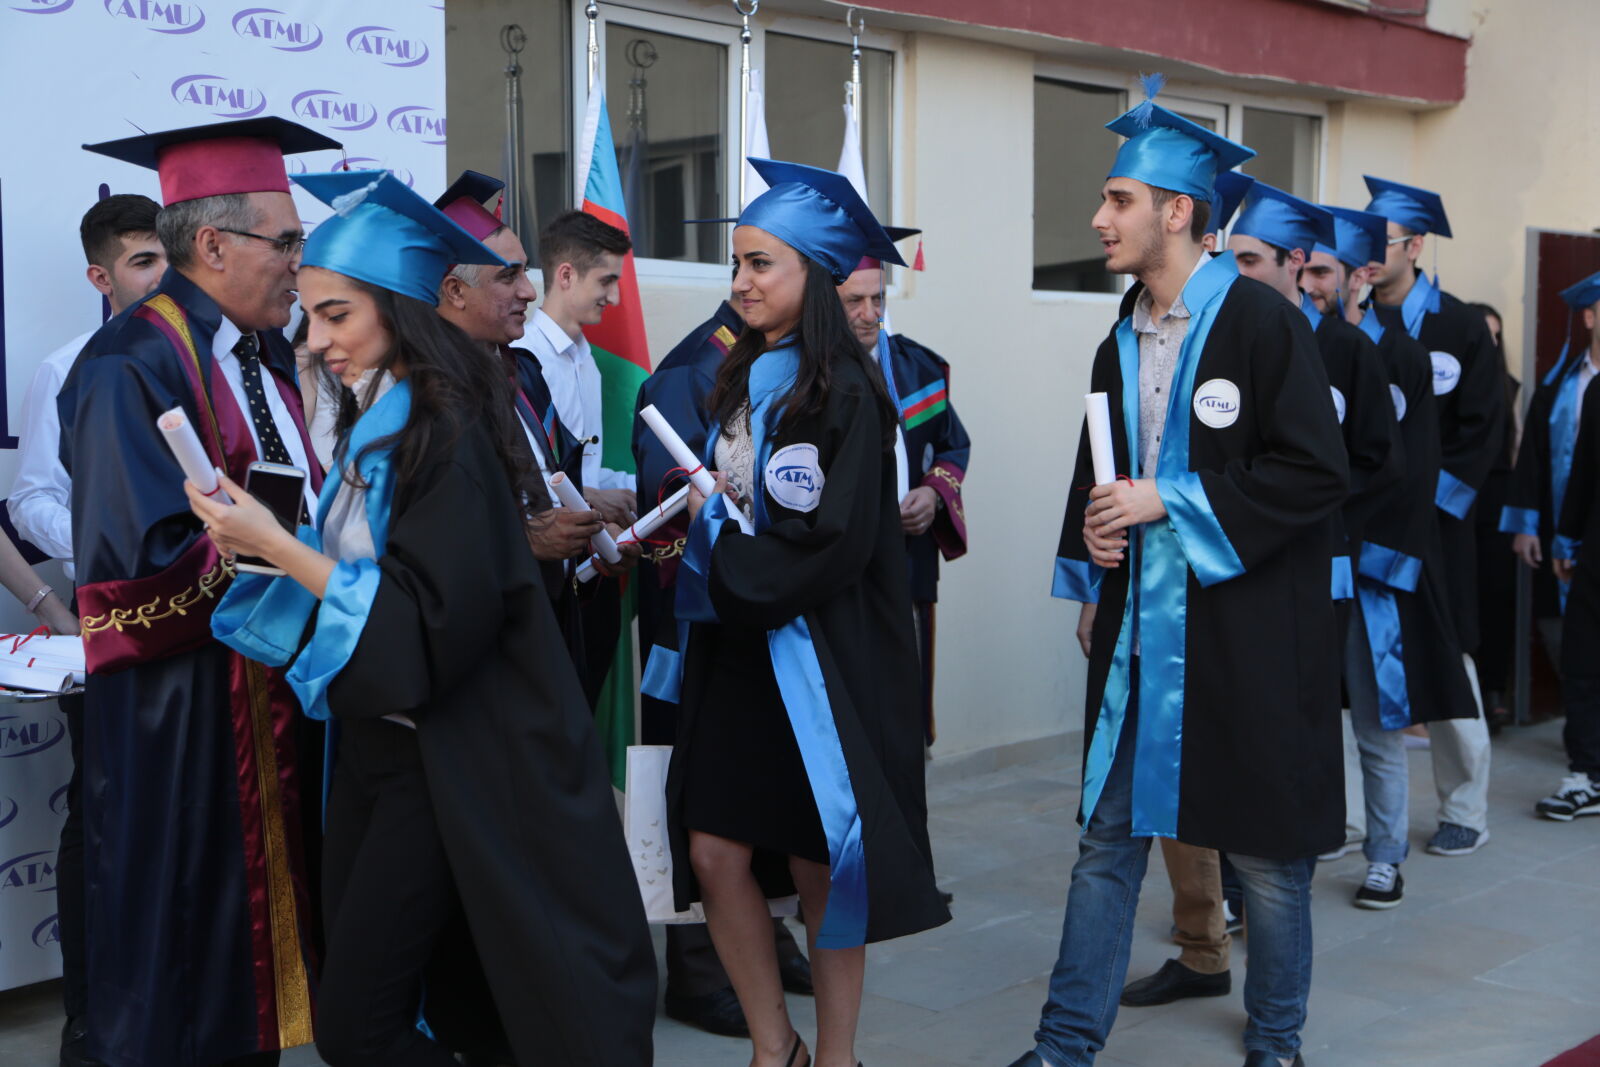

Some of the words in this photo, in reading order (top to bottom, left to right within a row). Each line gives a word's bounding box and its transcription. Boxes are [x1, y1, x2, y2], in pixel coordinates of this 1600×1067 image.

[242, 15, 310, 44] ATMU
[356, 33, 418, 60] ATMU
[182, 83, 253, 110] ATMU
[301, 98, 365, 123] ATMU
[780, 470, 812, 486] ATM
[1, 861, 58, 890] ATM
